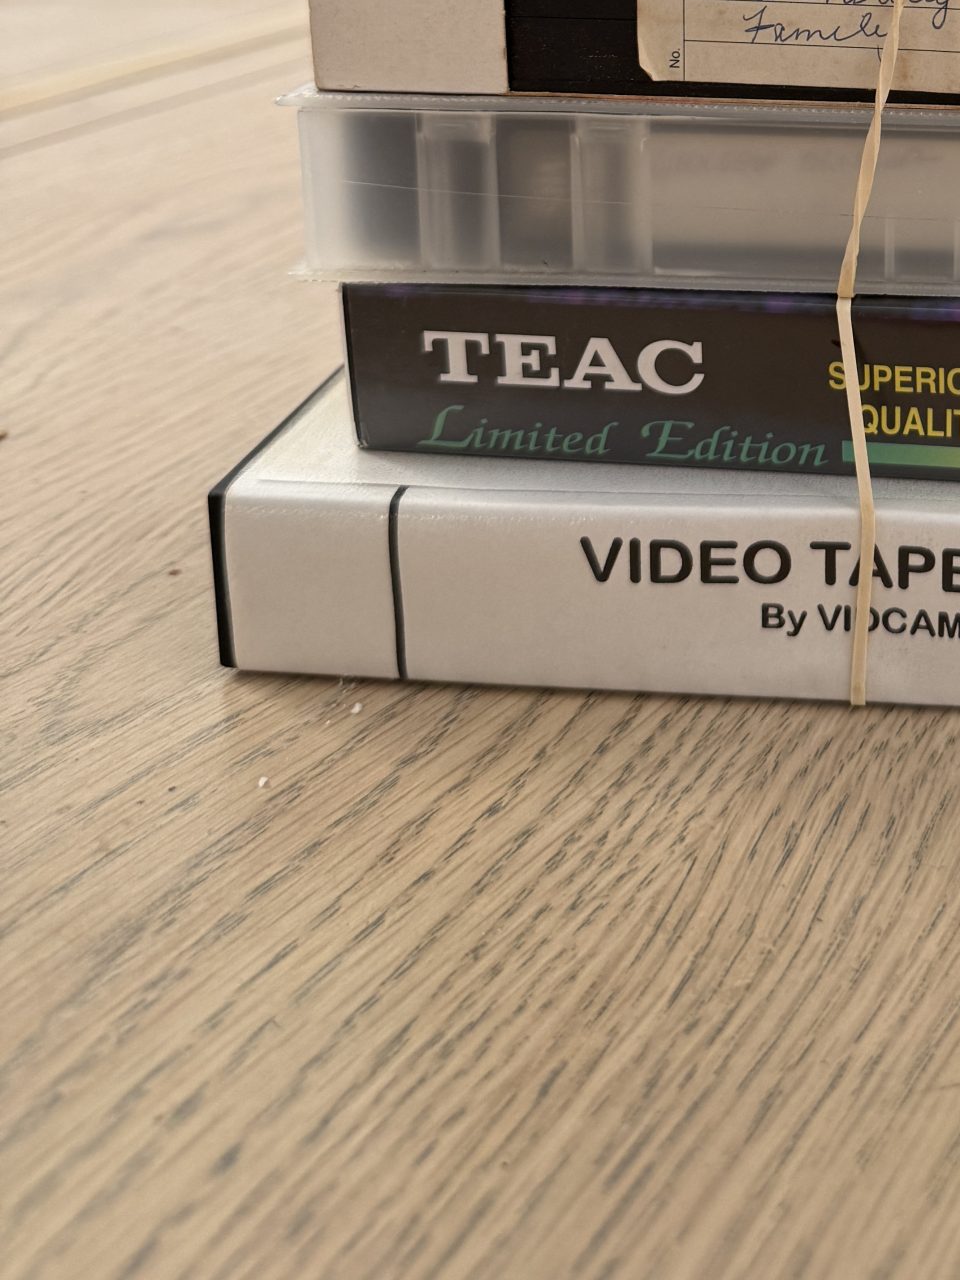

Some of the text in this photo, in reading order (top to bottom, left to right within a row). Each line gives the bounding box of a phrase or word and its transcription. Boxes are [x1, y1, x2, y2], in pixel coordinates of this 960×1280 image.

[668, 47, 681, 69] No.
[422, 329, 705, 395] TEAC
[416, 404, 828, 468] Limited Edition
[579, 535, 793, 586] VIDEO
[760, 602, 808, 637] By
